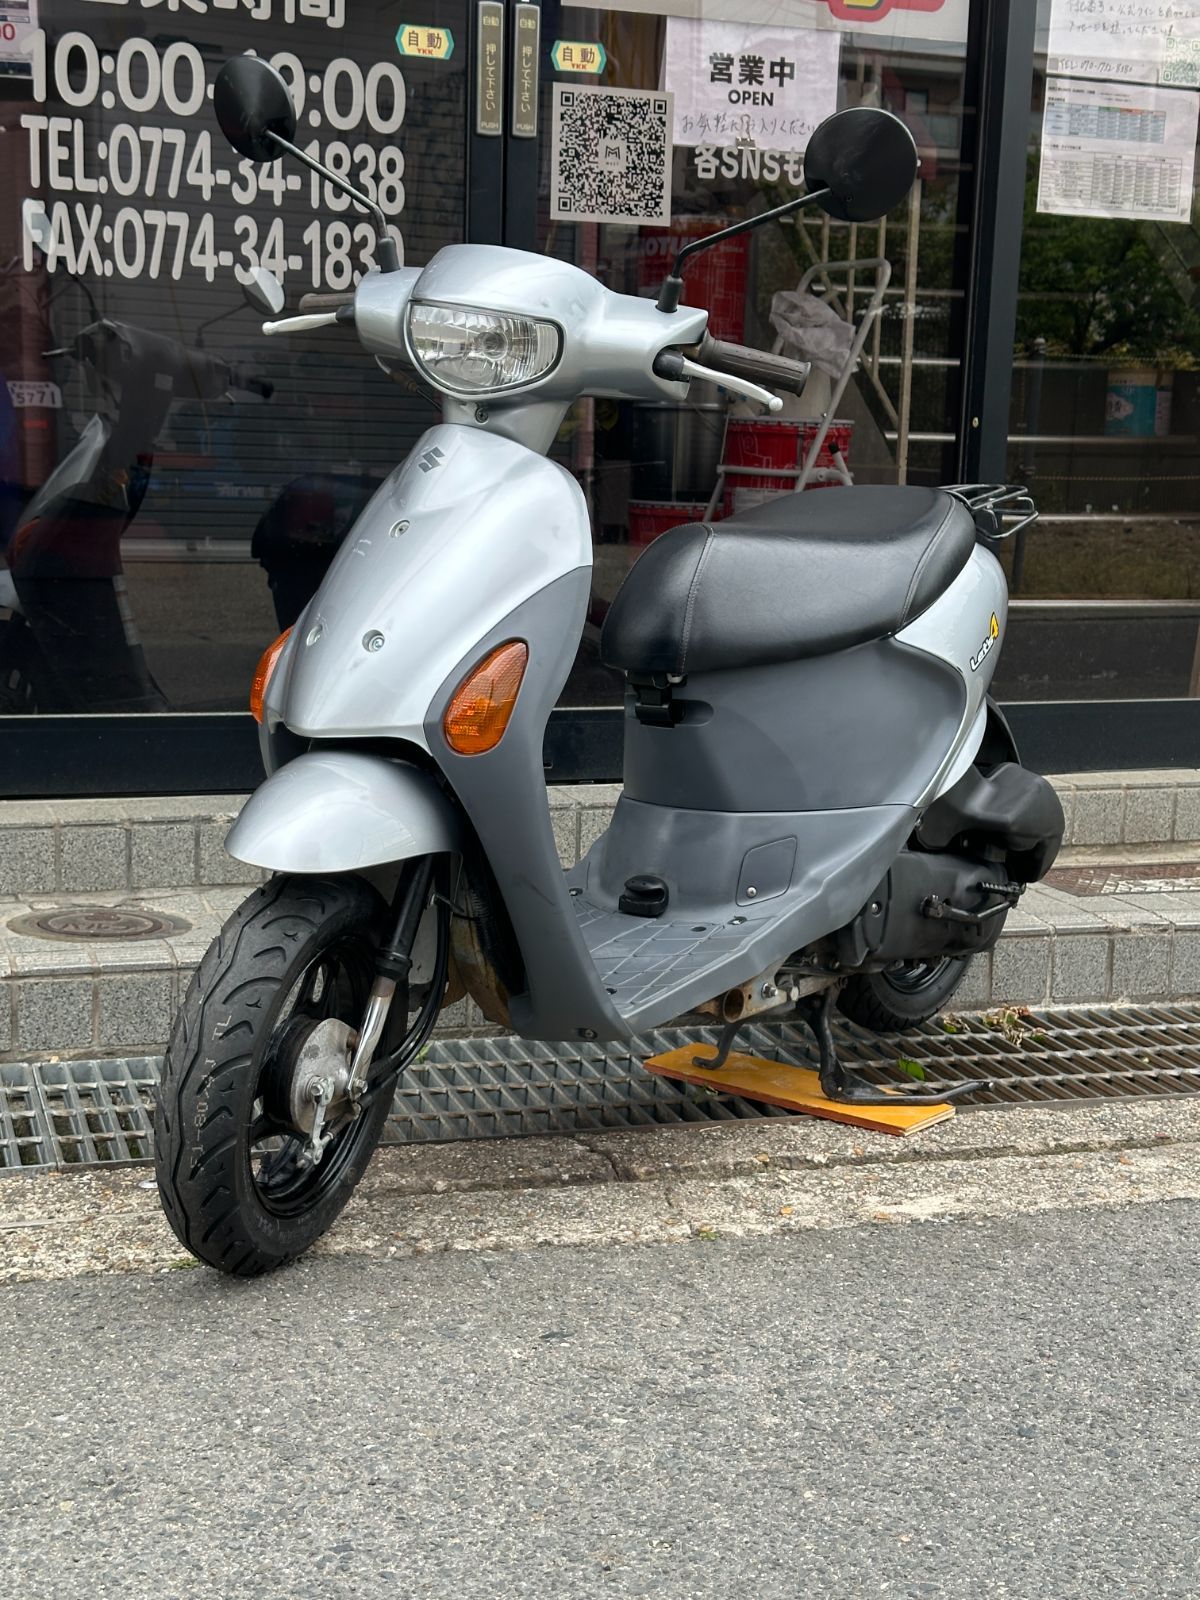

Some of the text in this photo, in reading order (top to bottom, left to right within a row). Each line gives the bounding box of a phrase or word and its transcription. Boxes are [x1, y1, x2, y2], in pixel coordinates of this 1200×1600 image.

[408, 30, 442, 49] 自動
[561, 47, 595, 64] 自動
[571, 62, 587, 70] YKK
[709, 52, 796, 88] 営業中
[485, 43, 497, 111] 押して下さい
[521, 45, 533, 113] 押して下さい
[728, 89, 774, 107] OPEN
[481, 121, 499, 129] PUSH
[20, 114, 406, 216] TEL:0774-34-1838
